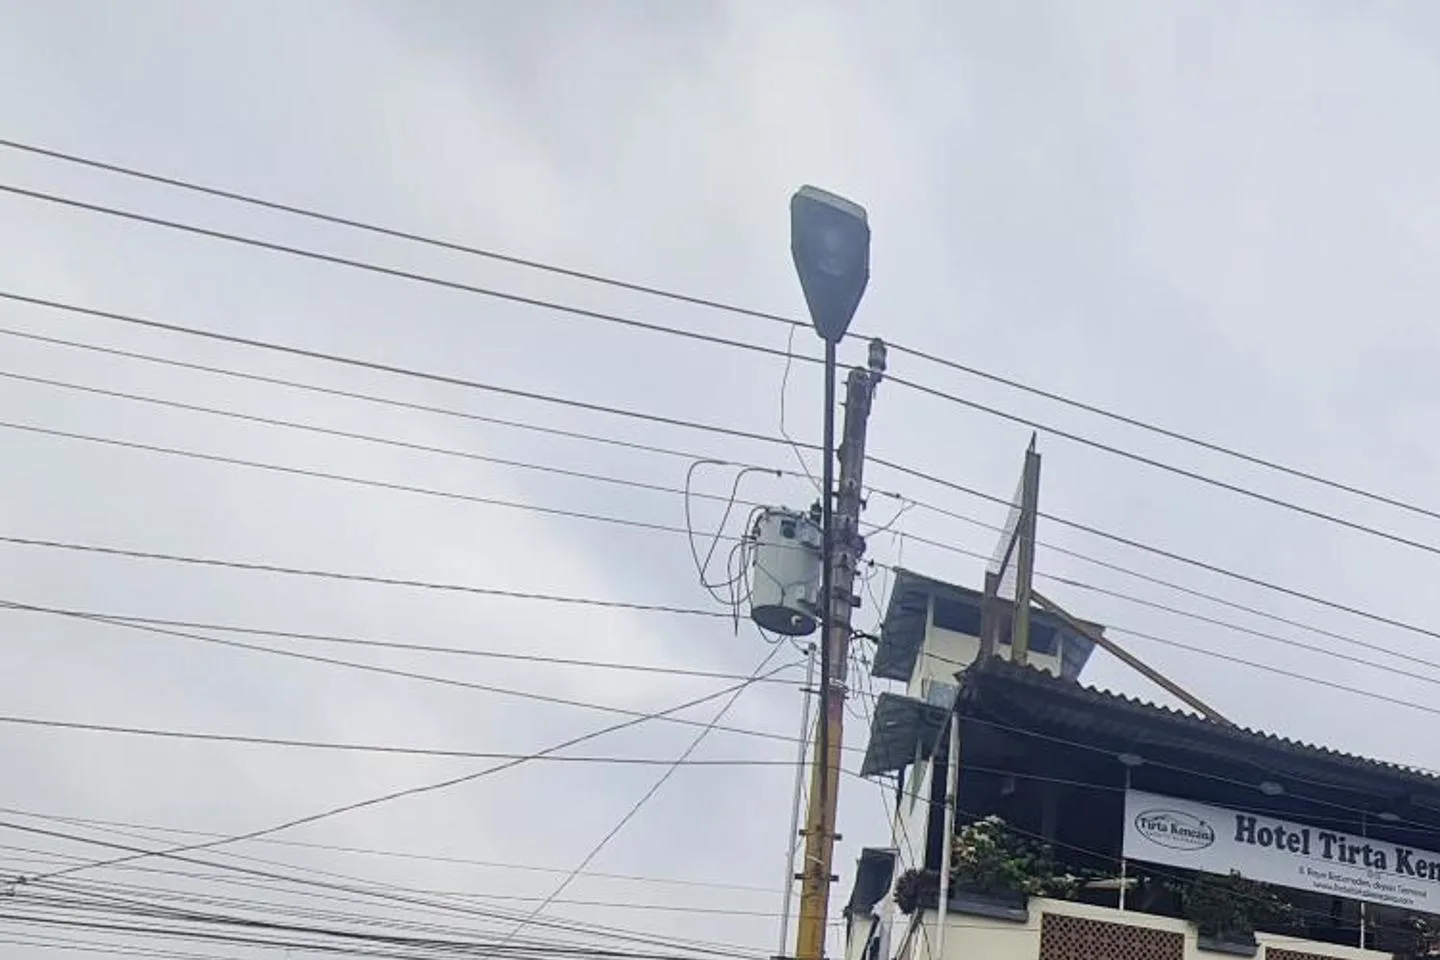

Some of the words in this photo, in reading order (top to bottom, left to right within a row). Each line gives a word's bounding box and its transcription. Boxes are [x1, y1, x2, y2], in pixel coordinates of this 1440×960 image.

[1140, 817, 1169, 832] Tirta
[1235, 814, 1310, 855] Hotel
[1319, 832, 1387, 871] Tirta
